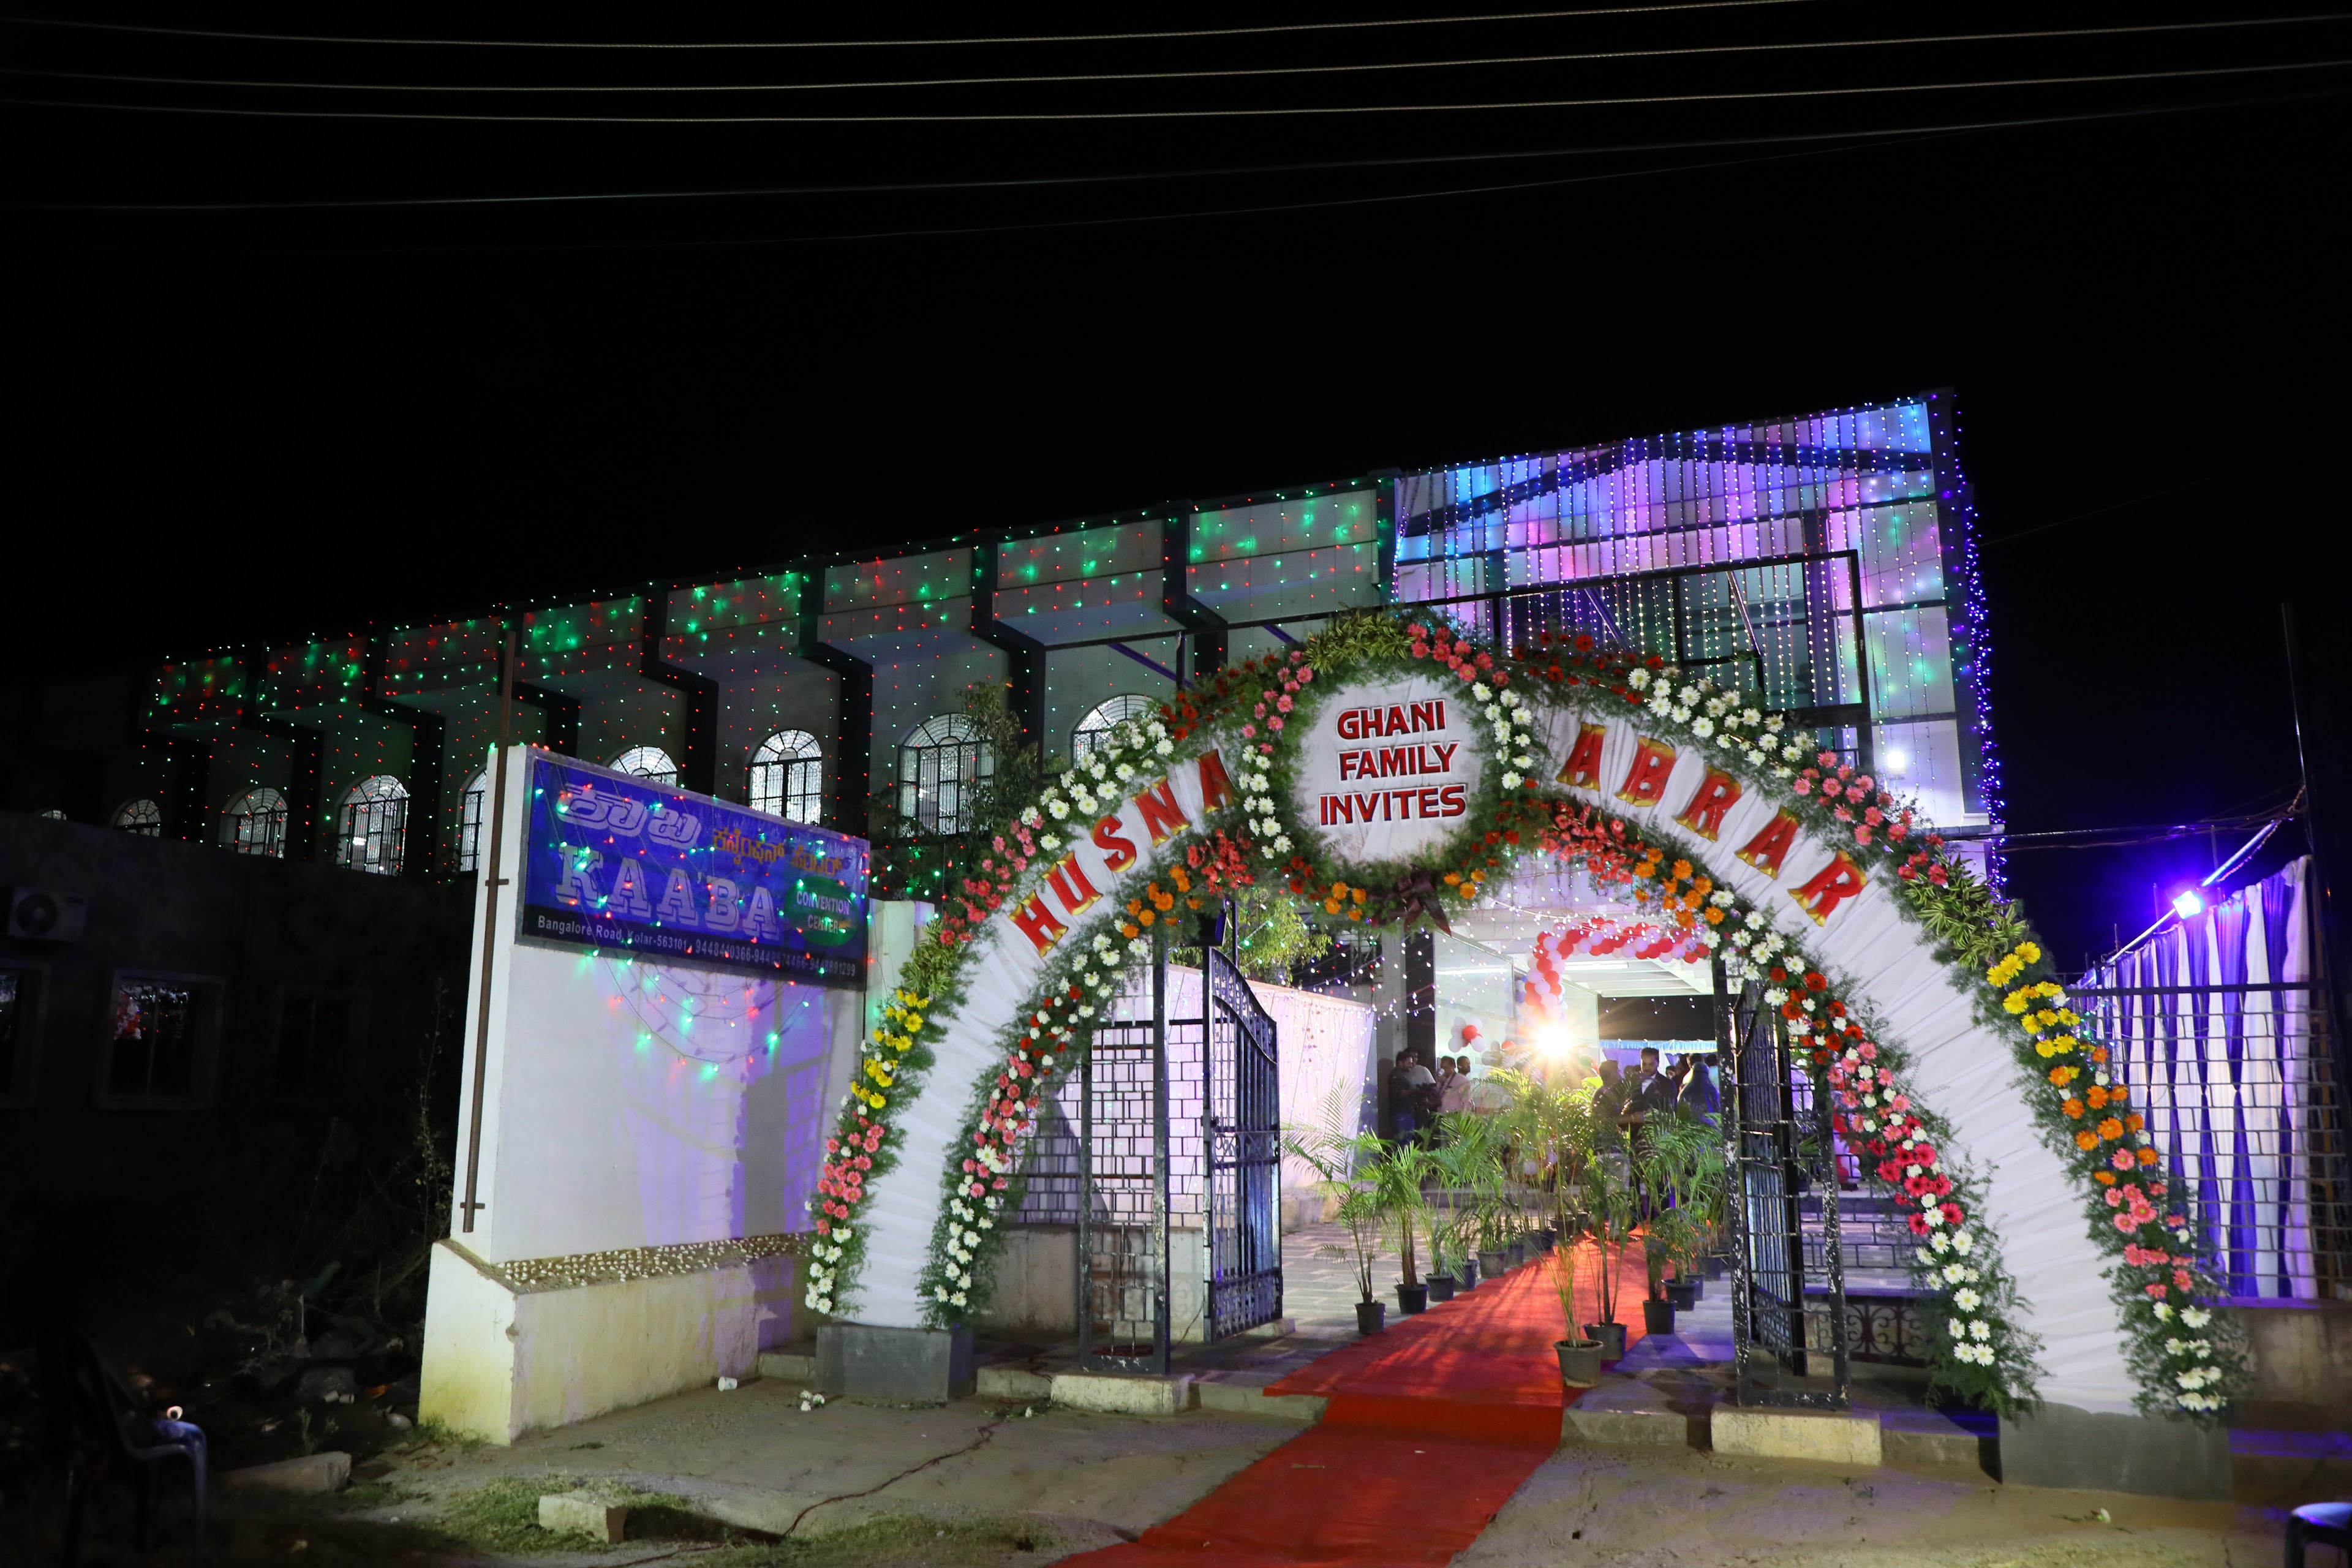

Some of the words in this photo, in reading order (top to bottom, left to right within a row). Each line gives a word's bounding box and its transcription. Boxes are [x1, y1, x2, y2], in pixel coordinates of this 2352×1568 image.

[1336, 699, 1446, 740] GHANI
[1338, 741, 1459, 781] FAMILY
[1319, 784, 1467, 826] INVITES
[1556, 722, 1868, 927] ABRAR
[1009, 749, 1234, 957] HUSNA
[796, 890, 850, 916] CONVENTION
[538, 915, 592, 935] Bangalore
[807, 914, 839, 935] CENTER
